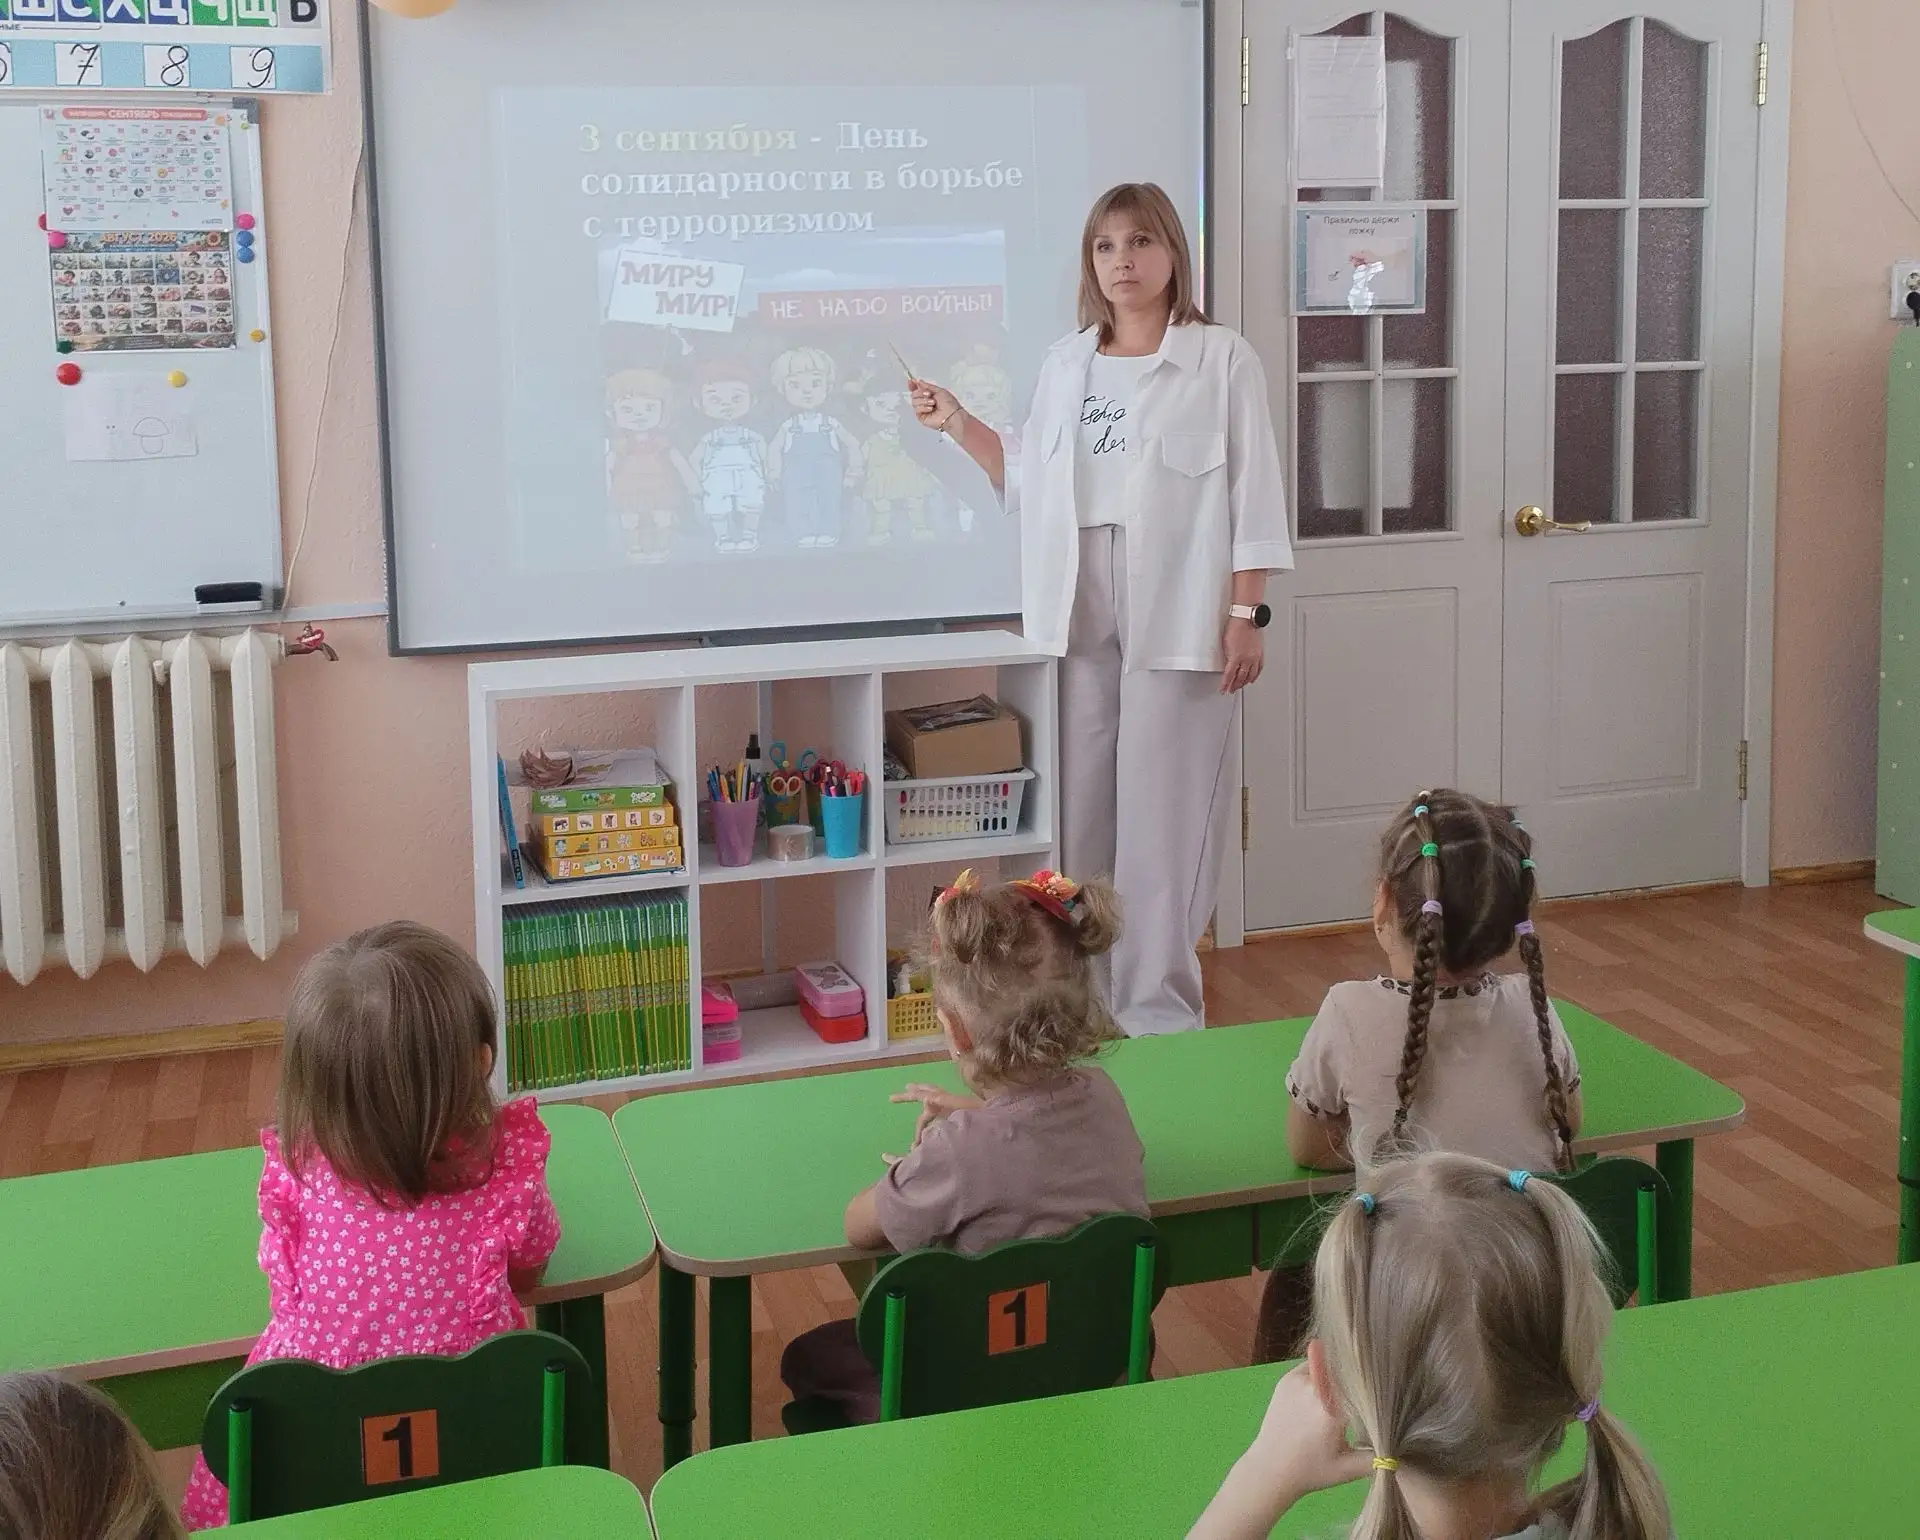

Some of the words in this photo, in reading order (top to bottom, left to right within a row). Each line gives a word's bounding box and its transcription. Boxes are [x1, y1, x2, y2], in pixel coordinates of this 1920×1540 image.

[69, 43, 99, 86] 7
[160, 45, 189, 87] 8
[247, 47, 275, 88] 9
[578, 124, 600, 154] 3
[614, 123, 799, 157] сентября
[835, 121, 930, 154] День
[580, 169, 854, 200] солидарности
[863, 169, 887, 191] в
[897, 159, 1025, 194] борьбе
[583, 214, 603, 239] с
[614, 208, 877, 245] терроризмом
[620, 260, 715, 290] МИРУ
[654, 289, 737, 319] МИР!
[769, 299, 802, 320] НЕ
[818, 296, 888, 319] НАДО
[1002, 1288, 1027, 1347] 1
[382, 1418, 414, 1478] 1
